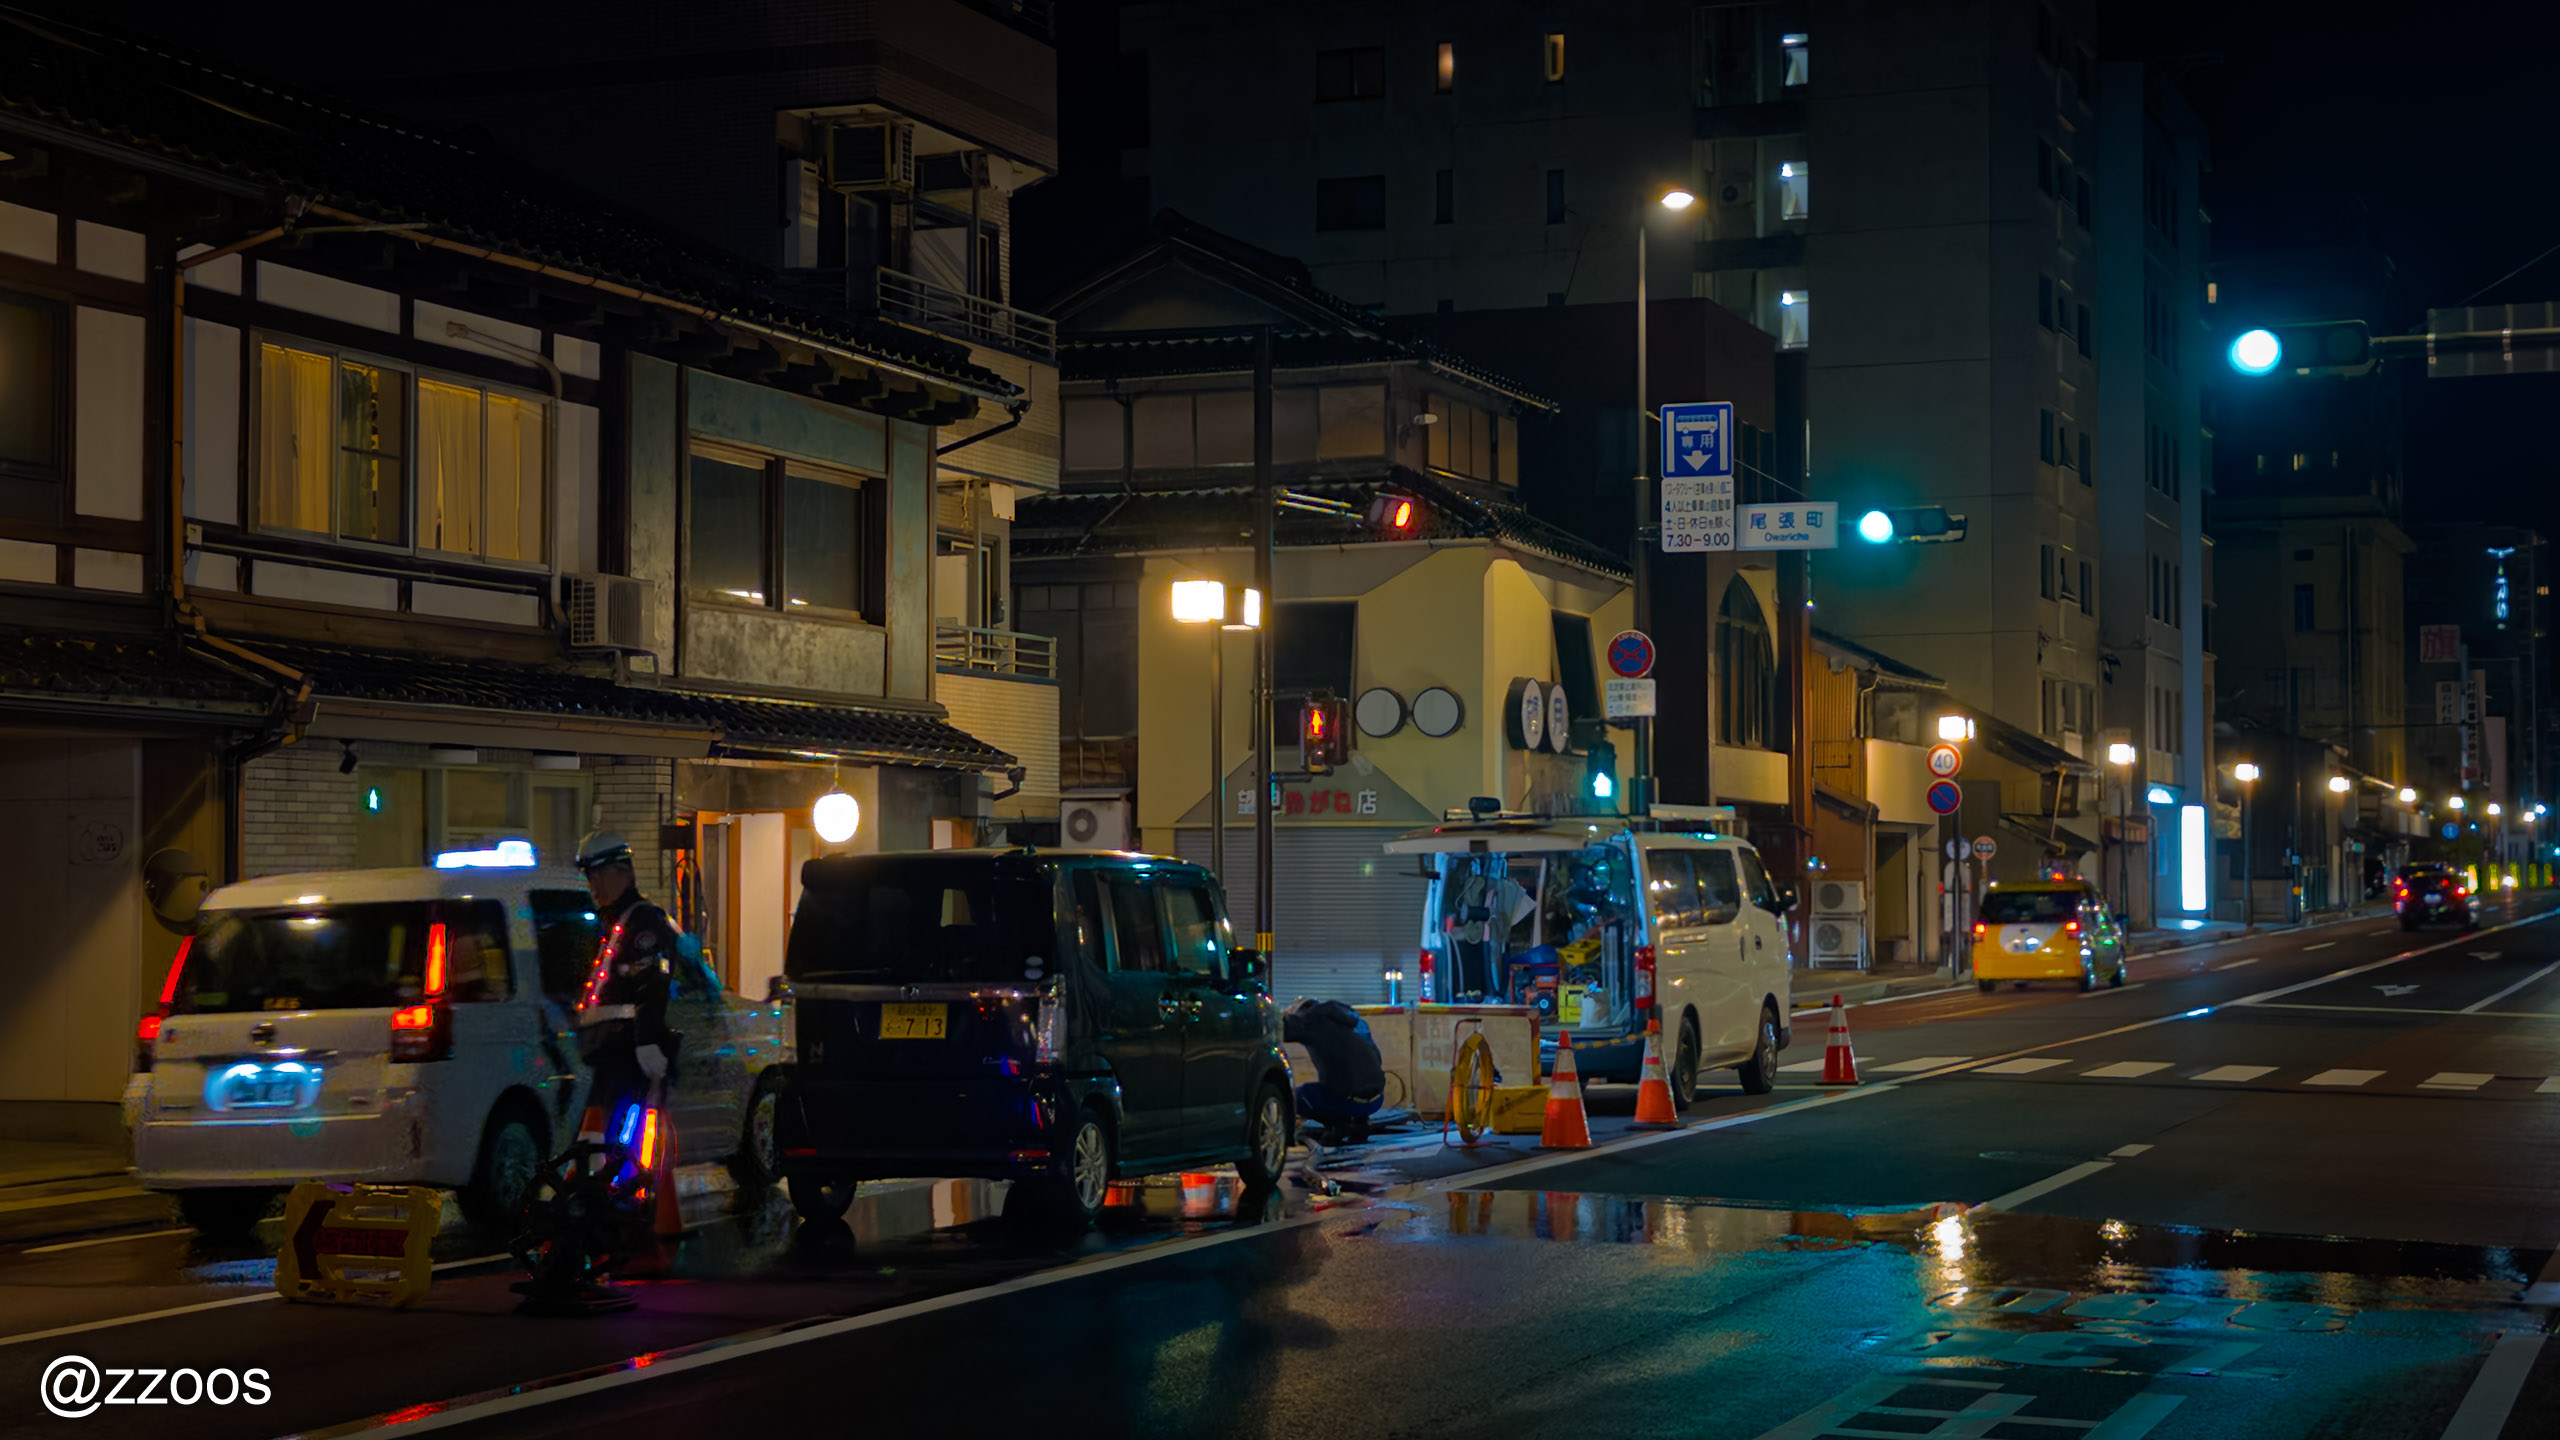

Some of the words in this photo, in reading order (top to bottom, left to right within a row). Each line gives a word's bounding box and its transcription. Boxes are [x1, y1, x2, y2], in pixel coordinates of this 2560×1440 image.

[1751, 511, 1822, 530] 尾張町
[1934, 753, 1954, 769] 40
